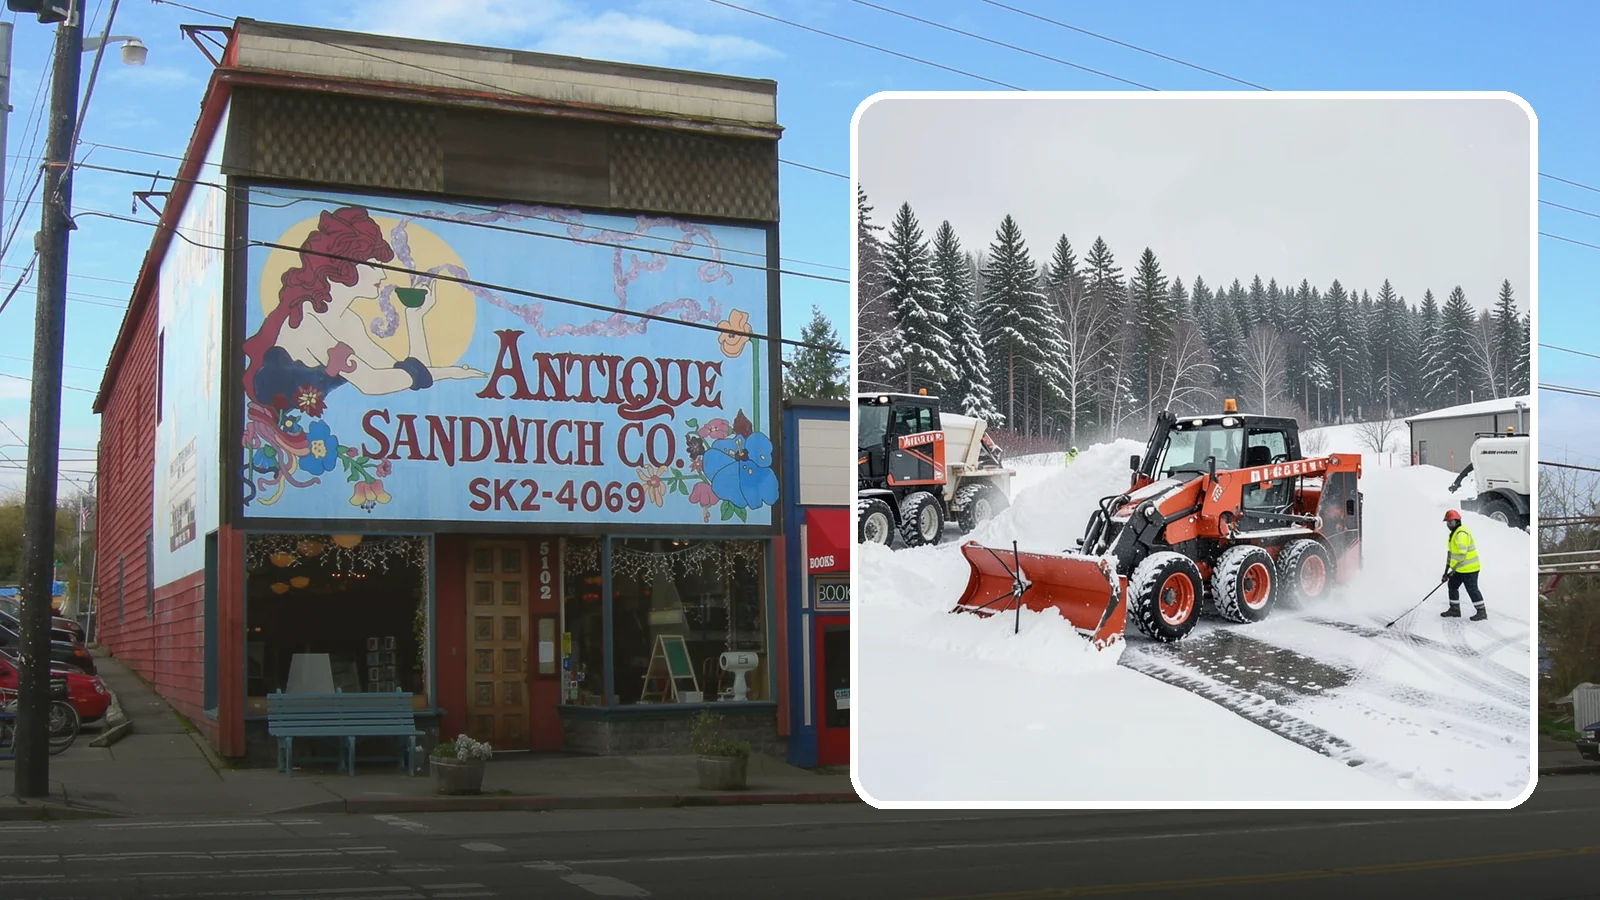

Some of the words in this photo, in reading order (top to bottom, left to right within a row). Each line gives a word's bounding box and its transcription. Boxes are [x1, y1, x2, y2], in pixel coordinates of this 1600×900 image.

[476, 329, 722, 420] ANTIQUE
[362, 409, 603, 466] SANDWICH
[616, 424, 685, 468] CO.
[469, 477, 645, 514] SK2-4069
[540, 542, 552, 599] 5102
[809, 555, 835, 569] BOOKS
